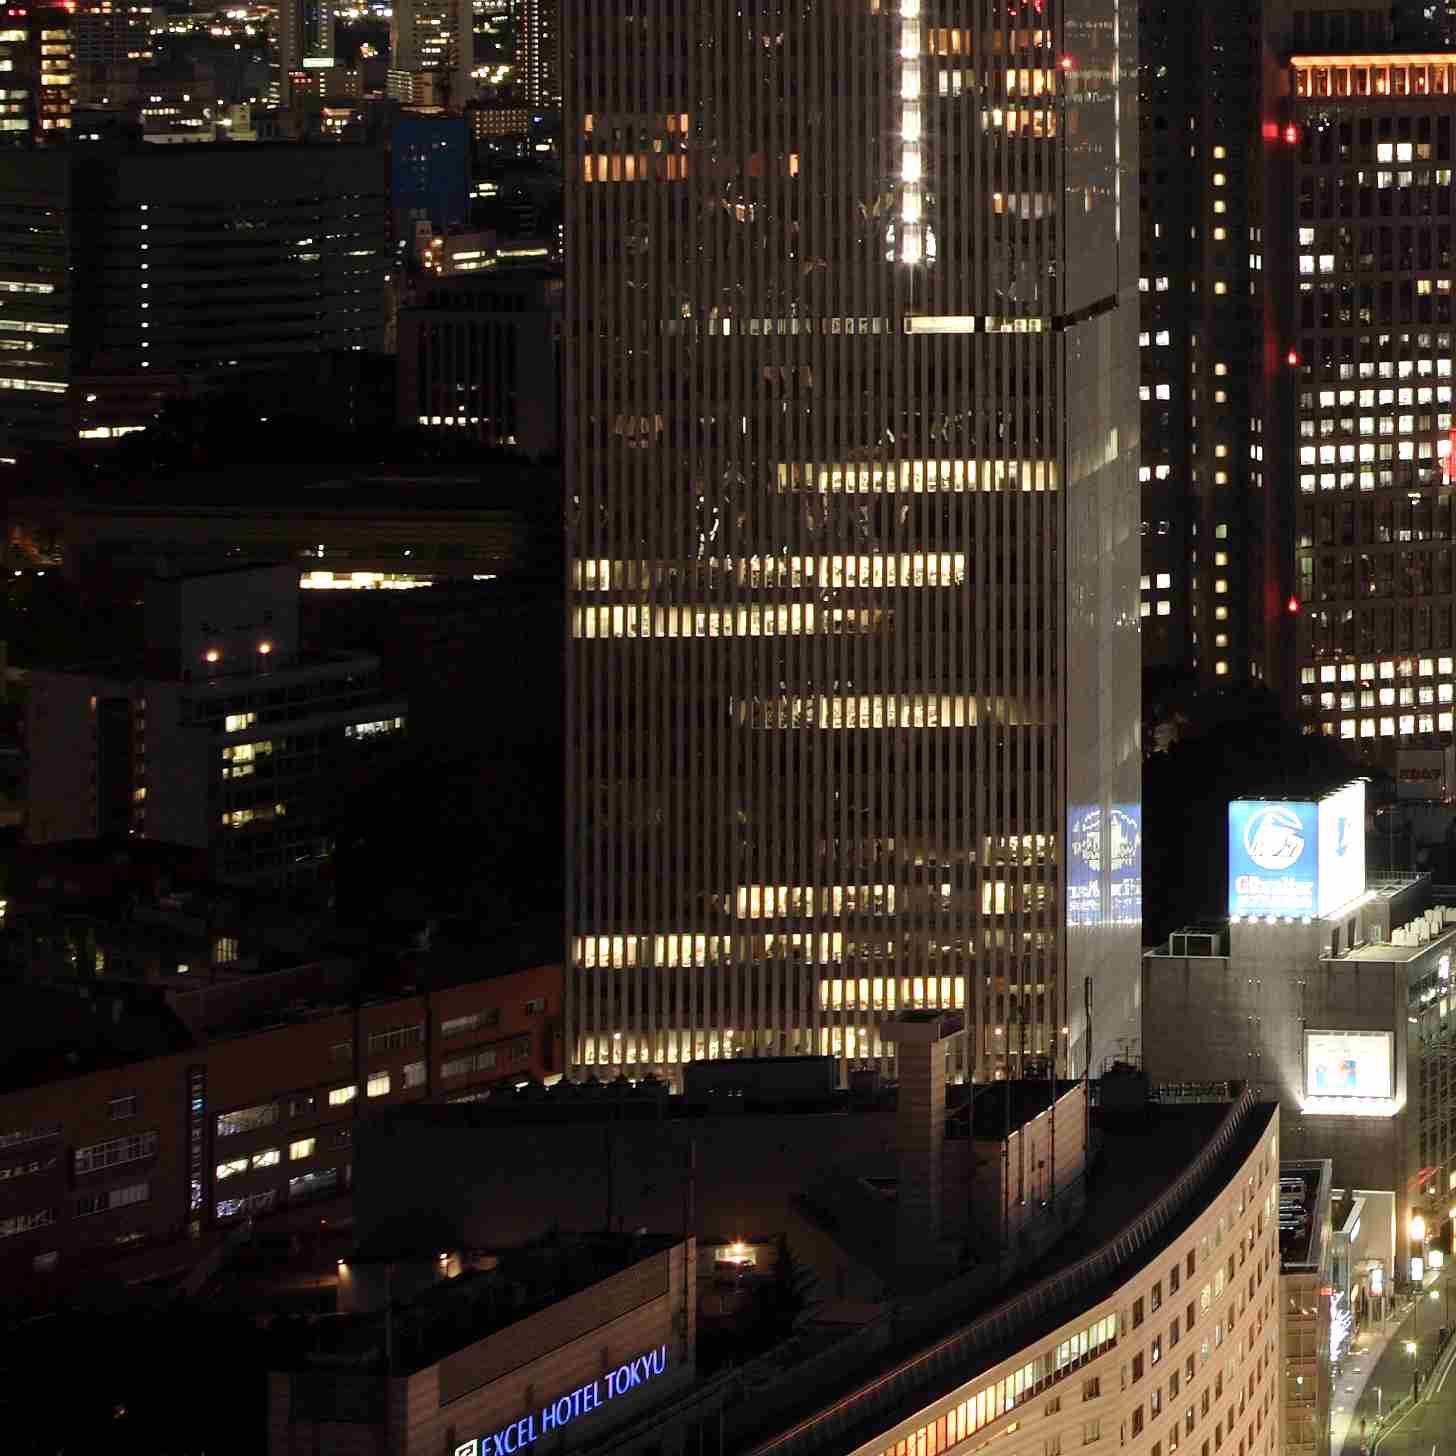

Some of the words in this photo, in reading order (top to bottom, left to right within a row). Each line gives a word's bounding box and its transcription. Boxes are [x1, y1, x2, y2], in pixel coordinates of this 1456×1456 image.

[481, 1415, 537, 1456] EXCEL
[541, 1380, 604, 1434] HOTEL
[604, 1344, 668, 1400] TOKYU
